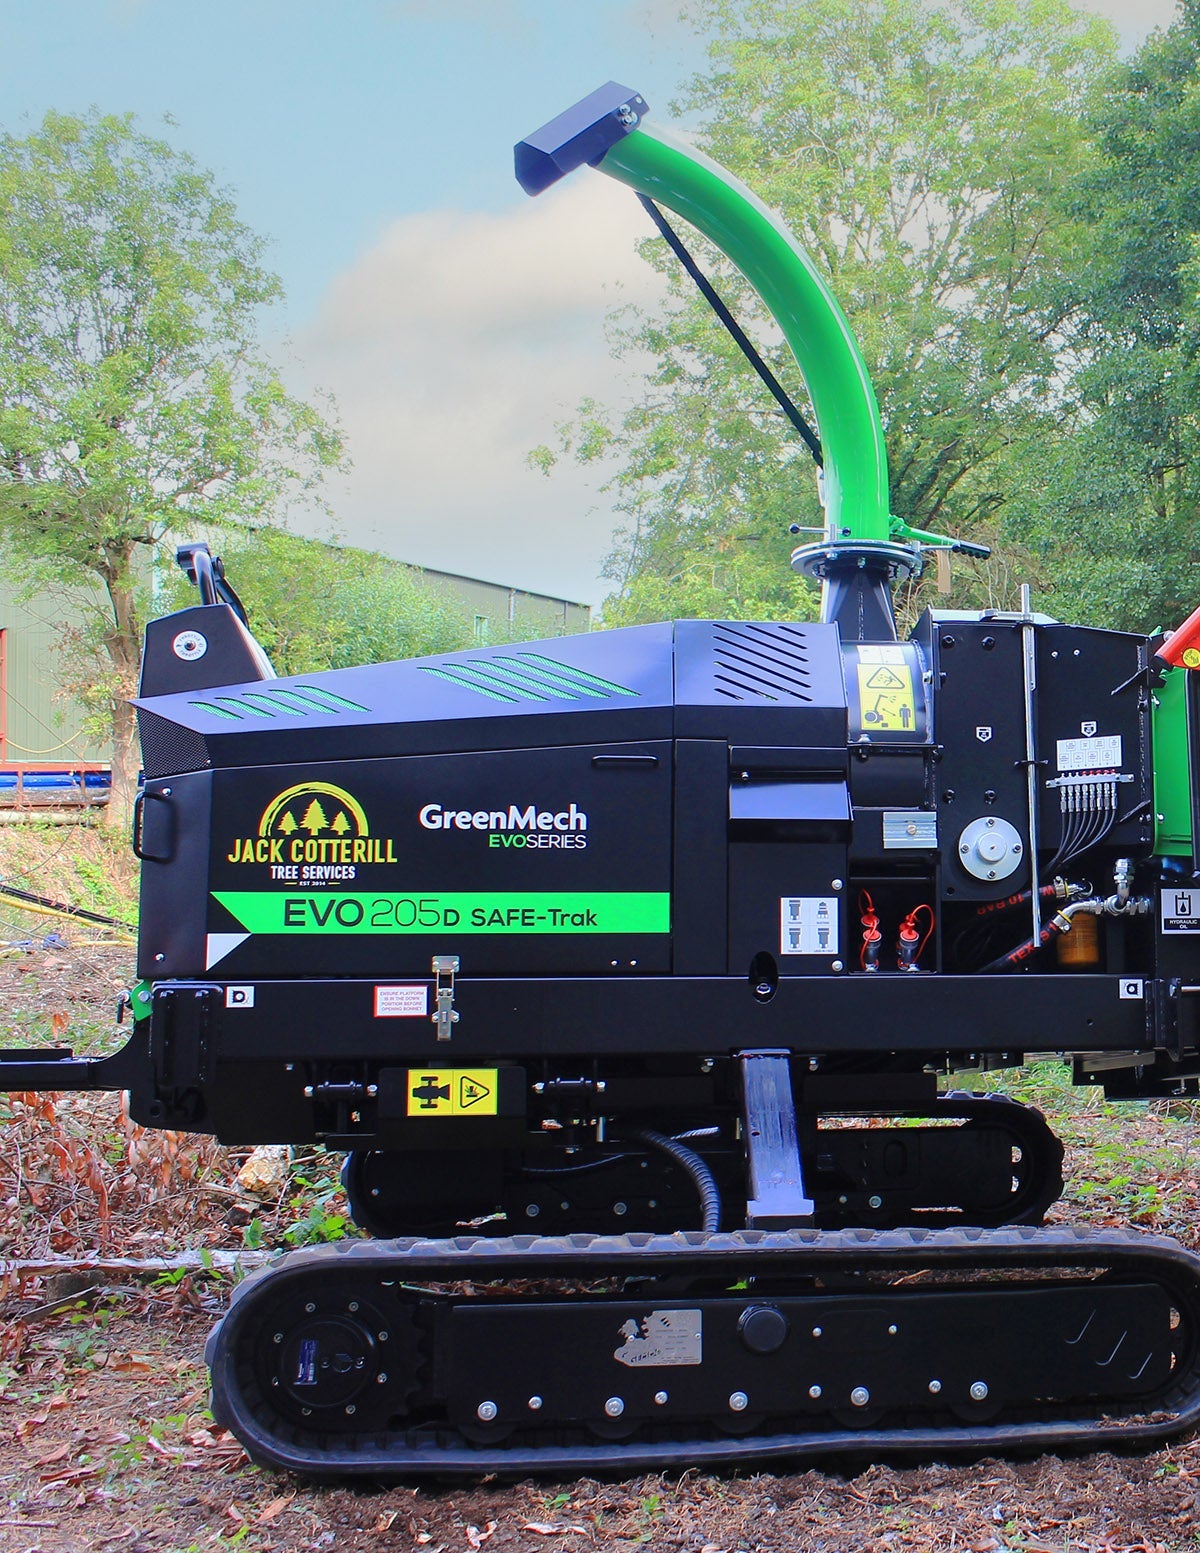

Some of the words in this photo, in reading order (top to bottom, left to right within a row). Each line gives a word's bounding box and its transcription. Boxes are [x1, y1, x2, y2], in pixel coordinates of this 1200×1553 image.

[419, 803, 588, 831] GreenMech
[227, 838, 285, 863] JACK
[291, 838, 398, 863] COTTERILL
[488, 834, 587, 849] EVOSERIES
[271, 865, 299, 880] TREE
[302, 865, 356, 880] SERVICES
[283, 898, 365, 927] EVO
[470, 908, 598, 927] SAFE-Trak
[1007, 930, 1050, 963] TEXS
